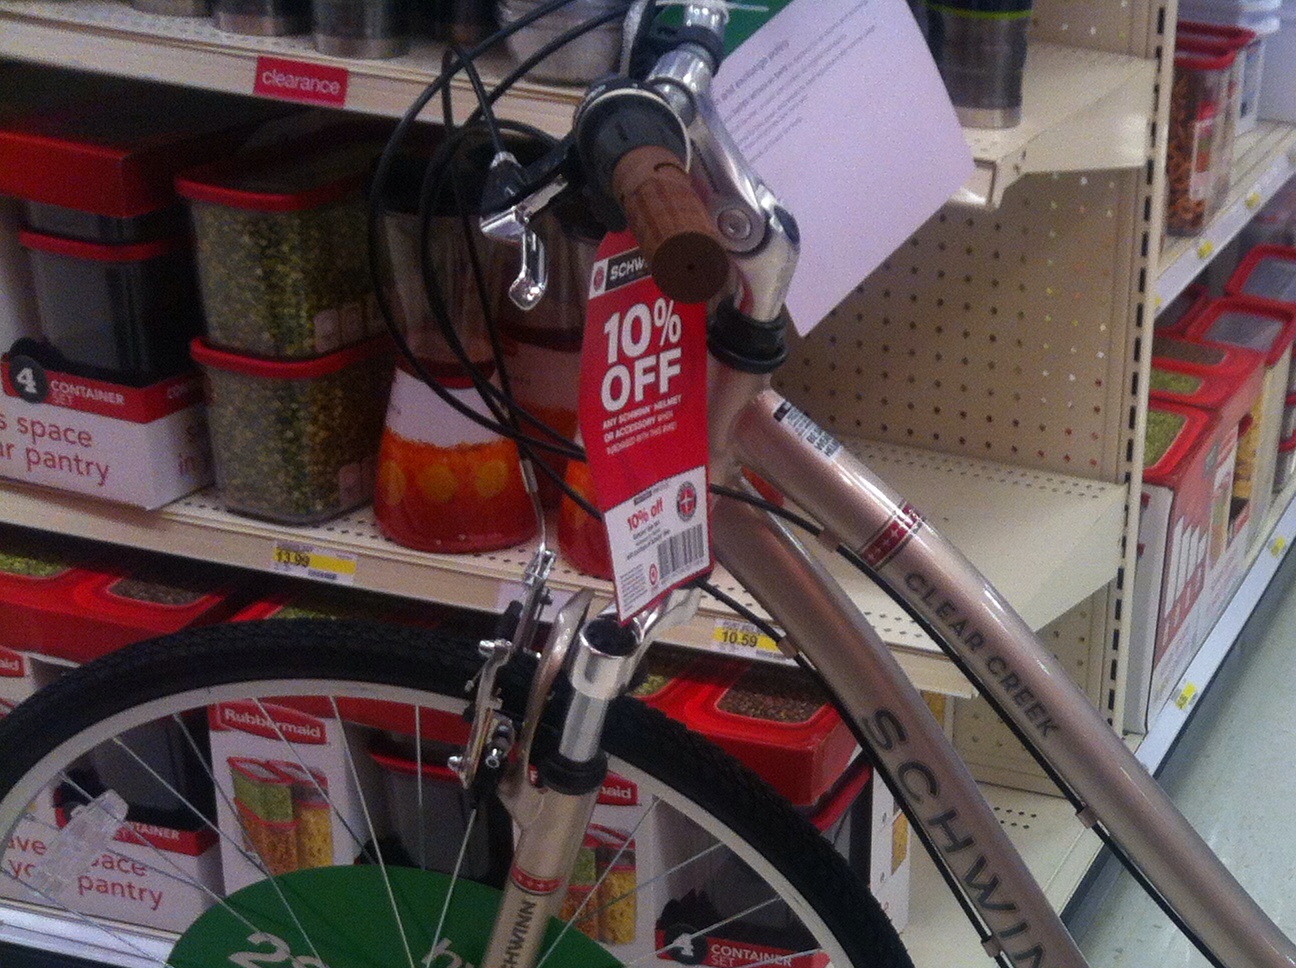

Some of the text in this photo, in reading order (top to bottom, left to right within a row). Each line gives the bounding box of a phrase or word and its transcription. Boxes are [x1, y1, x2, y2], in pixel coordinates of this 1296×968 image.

[262, 68, 341, 95] clearance
[609, 256, 650, 281] SCHW
[604, 298, 682, 364] 10%
[16, 367, 125, 406] 4 CONTAINER
[601, 347, 682, 412] OFF
[16, 415, 93, 449] space
[25, 446, 110, 487] pantry
[626, 497, 664, 531] 10% off
[722, 629, 758, 648] 10.59
[905, 572, 1058, 738] CLEAR CREEK
[90, 852, 148, 877] ace
[77, 874, 164, 911] pantry
[710, 944, 793, 968] CONTAINER
[710, 955, 735, 968] SET
